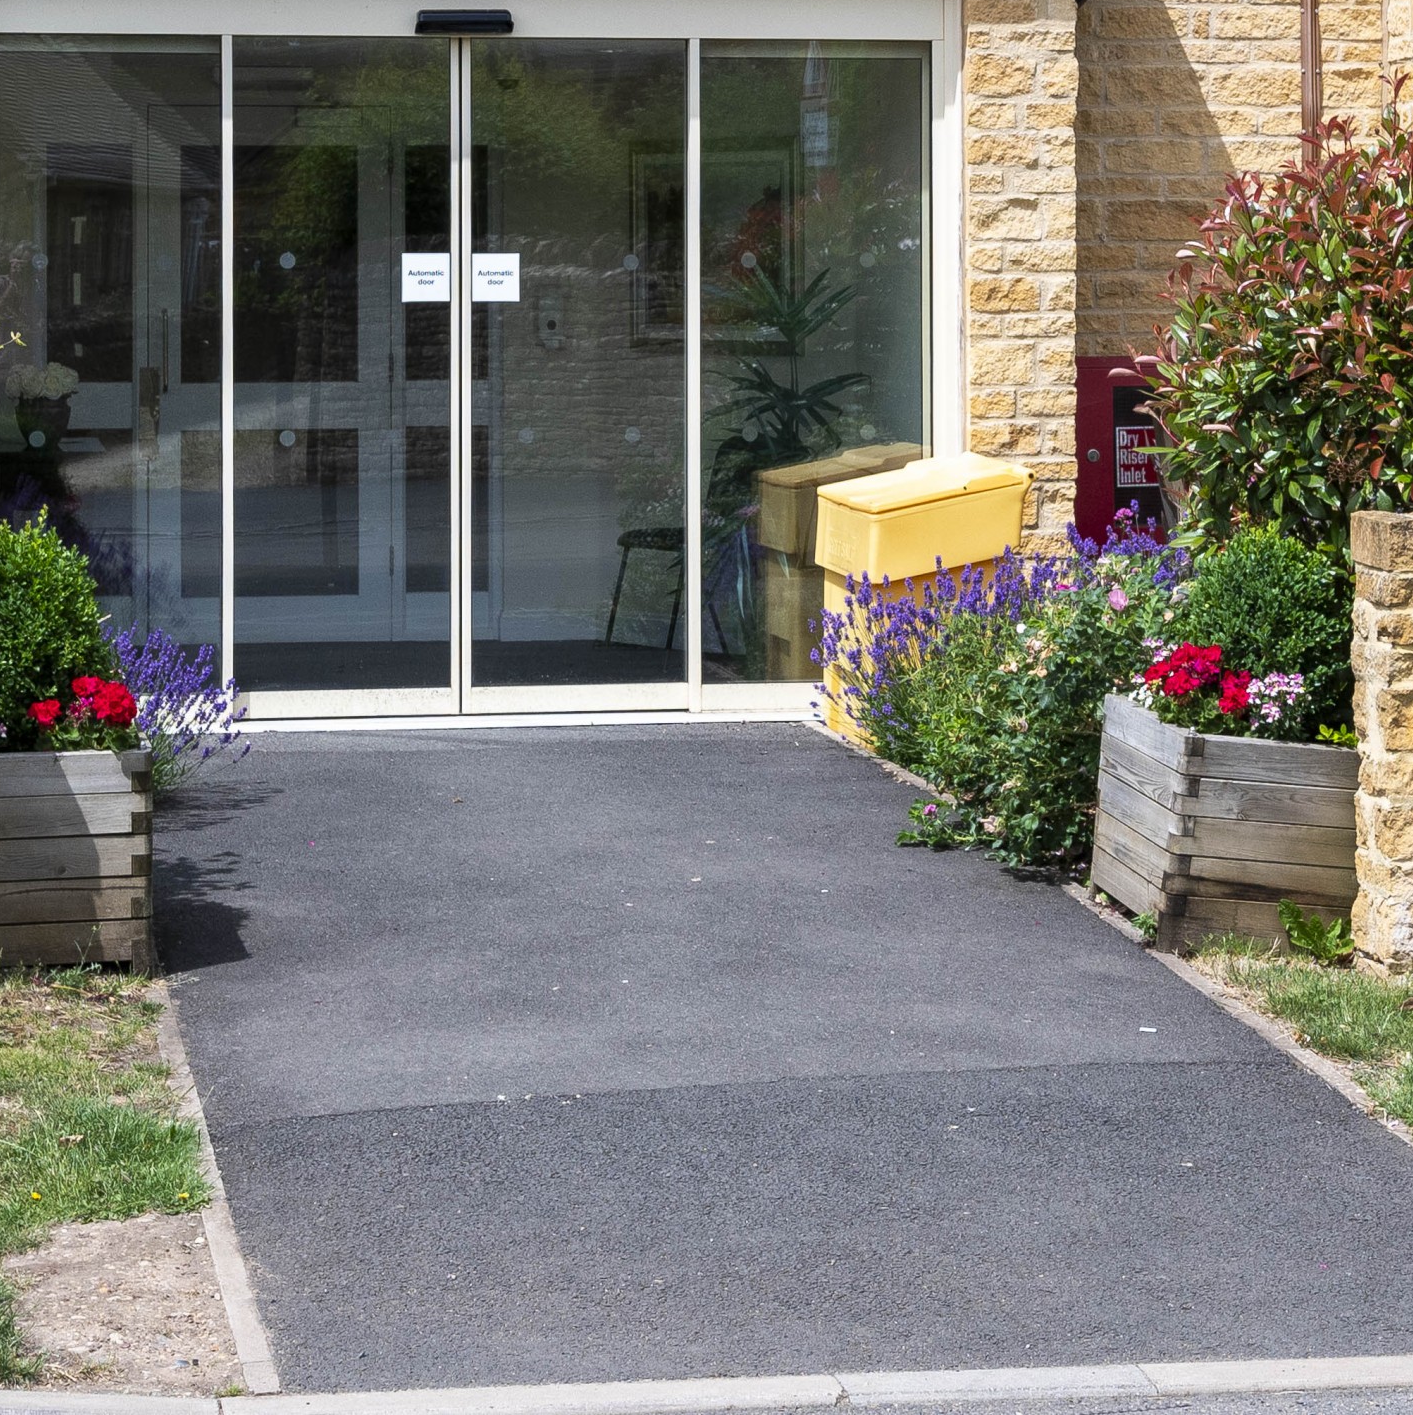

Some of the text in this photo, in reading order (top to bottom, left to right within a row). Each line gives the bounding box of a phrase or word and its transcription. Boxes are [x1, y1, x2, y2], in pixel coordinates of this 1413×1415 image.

[407, 269, 444, 277] Automatic
[477, 269, 514, 277] Automatic
[417, 278, 435, 286] door
[487, 278, 504, 286] door
[1119, 430, 1139, 448] Dry
[1120, 449, 1149, 464] Riser
[1120, 466, 1147, 483] Inlet
